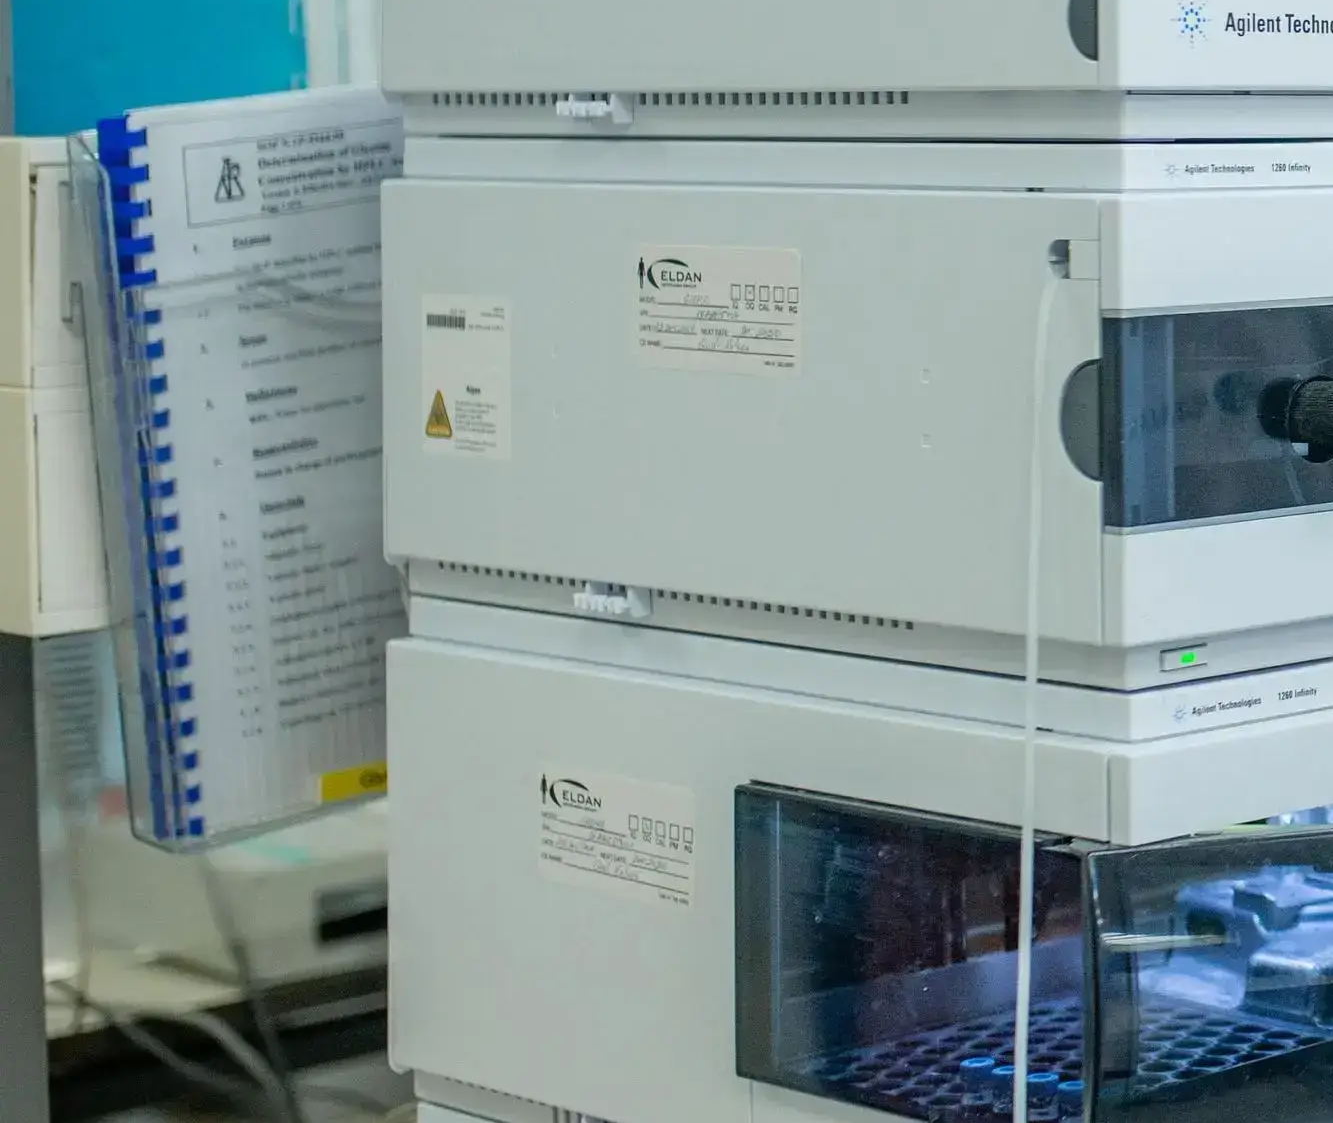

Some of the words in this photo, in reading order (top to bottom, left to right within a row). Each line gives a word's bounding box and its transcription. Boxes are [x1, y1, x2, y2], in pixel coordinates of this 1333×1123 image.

[1225, 12, 1281, 37] Agilent
[1184, 164, 1209, 175] Agilent
[1211, 164, 1255, 175] Technologies
[1271, 163, 1287, 173] 1260
[1288, 162, 1312, 174] Infinity
[660, 270, 703, 284] ELDAN
[1278, 690, 1293, 701] 1260
[1294, 687, 1317, 699] Infinity
[1192, 701, 1217, 717] Agilent
[1218, 697, 1262, 712] Technologies
[562, 790, 602, 808] ELDAN
